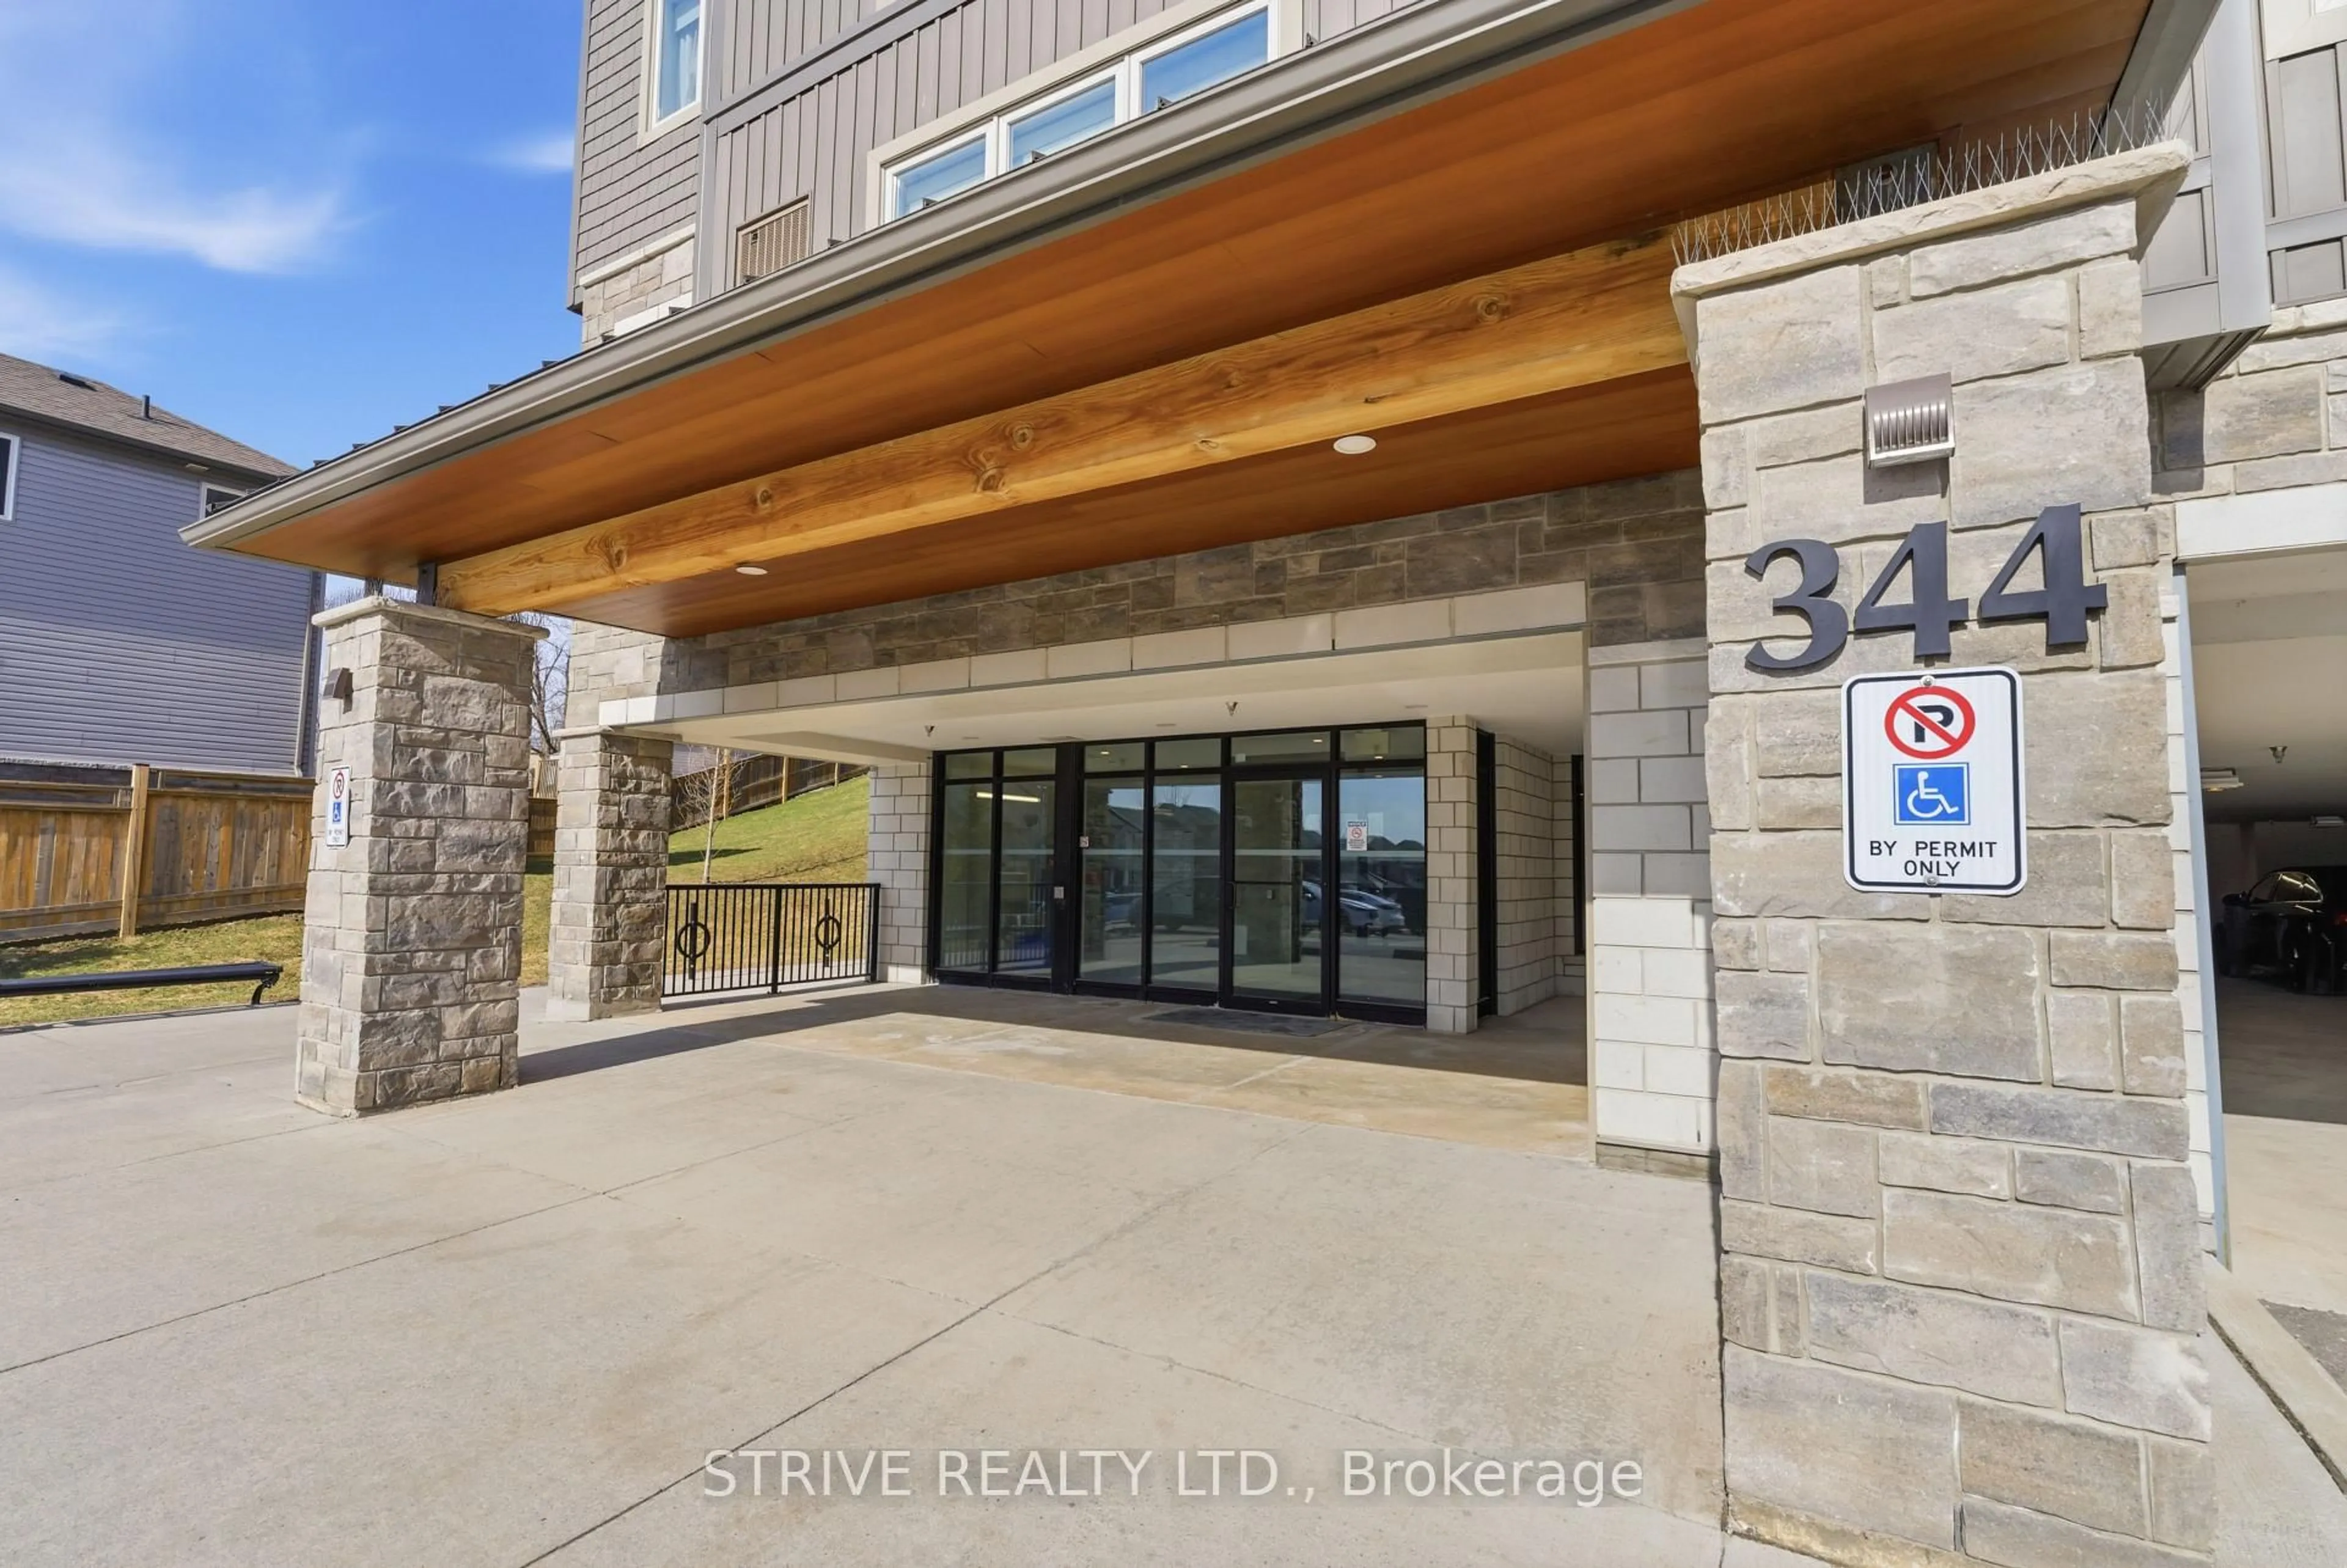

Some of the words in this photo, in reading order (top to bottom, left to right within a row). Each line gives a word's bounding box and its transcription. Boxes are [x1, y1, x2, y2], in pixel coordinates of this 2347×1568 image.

[1745, 503, 2108, 670] 344
[1870, 840, 1897, 856] BY
[1915, 840, 1997, 858] PERMIT
[1904, 860, 1961, 877] ONLY
